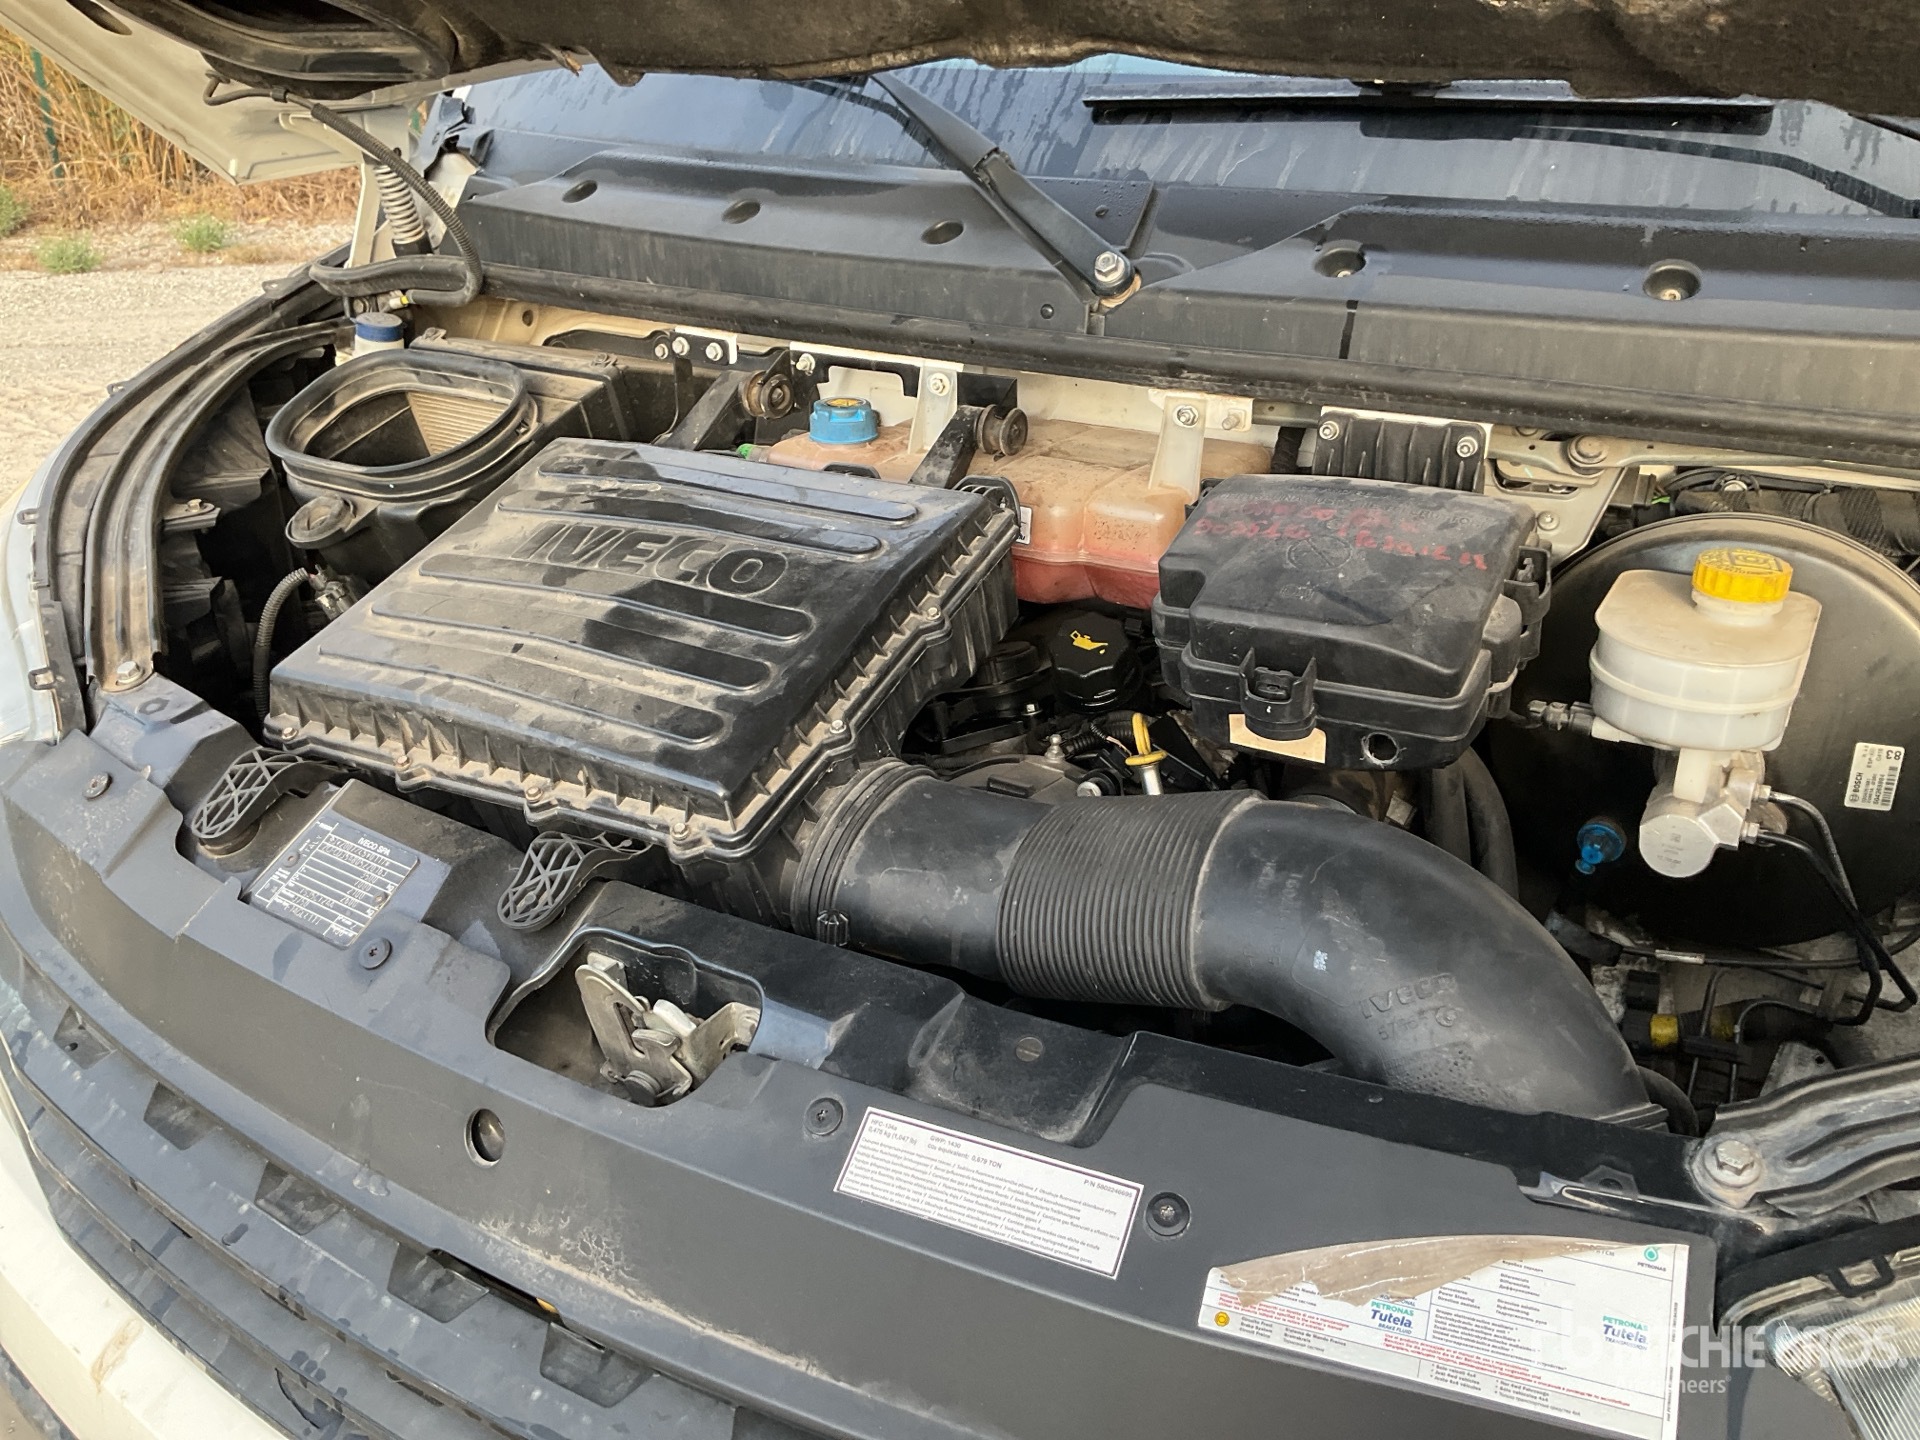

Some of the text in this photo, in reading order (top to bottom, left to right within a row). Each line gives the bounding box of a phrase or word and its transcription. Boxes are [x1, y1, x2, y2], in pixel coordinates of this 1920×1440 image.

[510, 520, 788, 596] IVECO
[1852, 772, 1863, 793] BOSCH
[356, 837, 392, 855] IVECO SPA
[870, 1119, 897, 1130] HFC-134a
[946, 1140, 961, 1148] 1430
[987, 1159, 1002, 1168] TON
[1371, 1301, 1414, 1316] PETRONAS
[1371, 1309, 1412, 1328] Tutela
[1603, 1315, 1648, 1331] PETRONAS
[1603, 1324, 1647, 1343] Tutela
